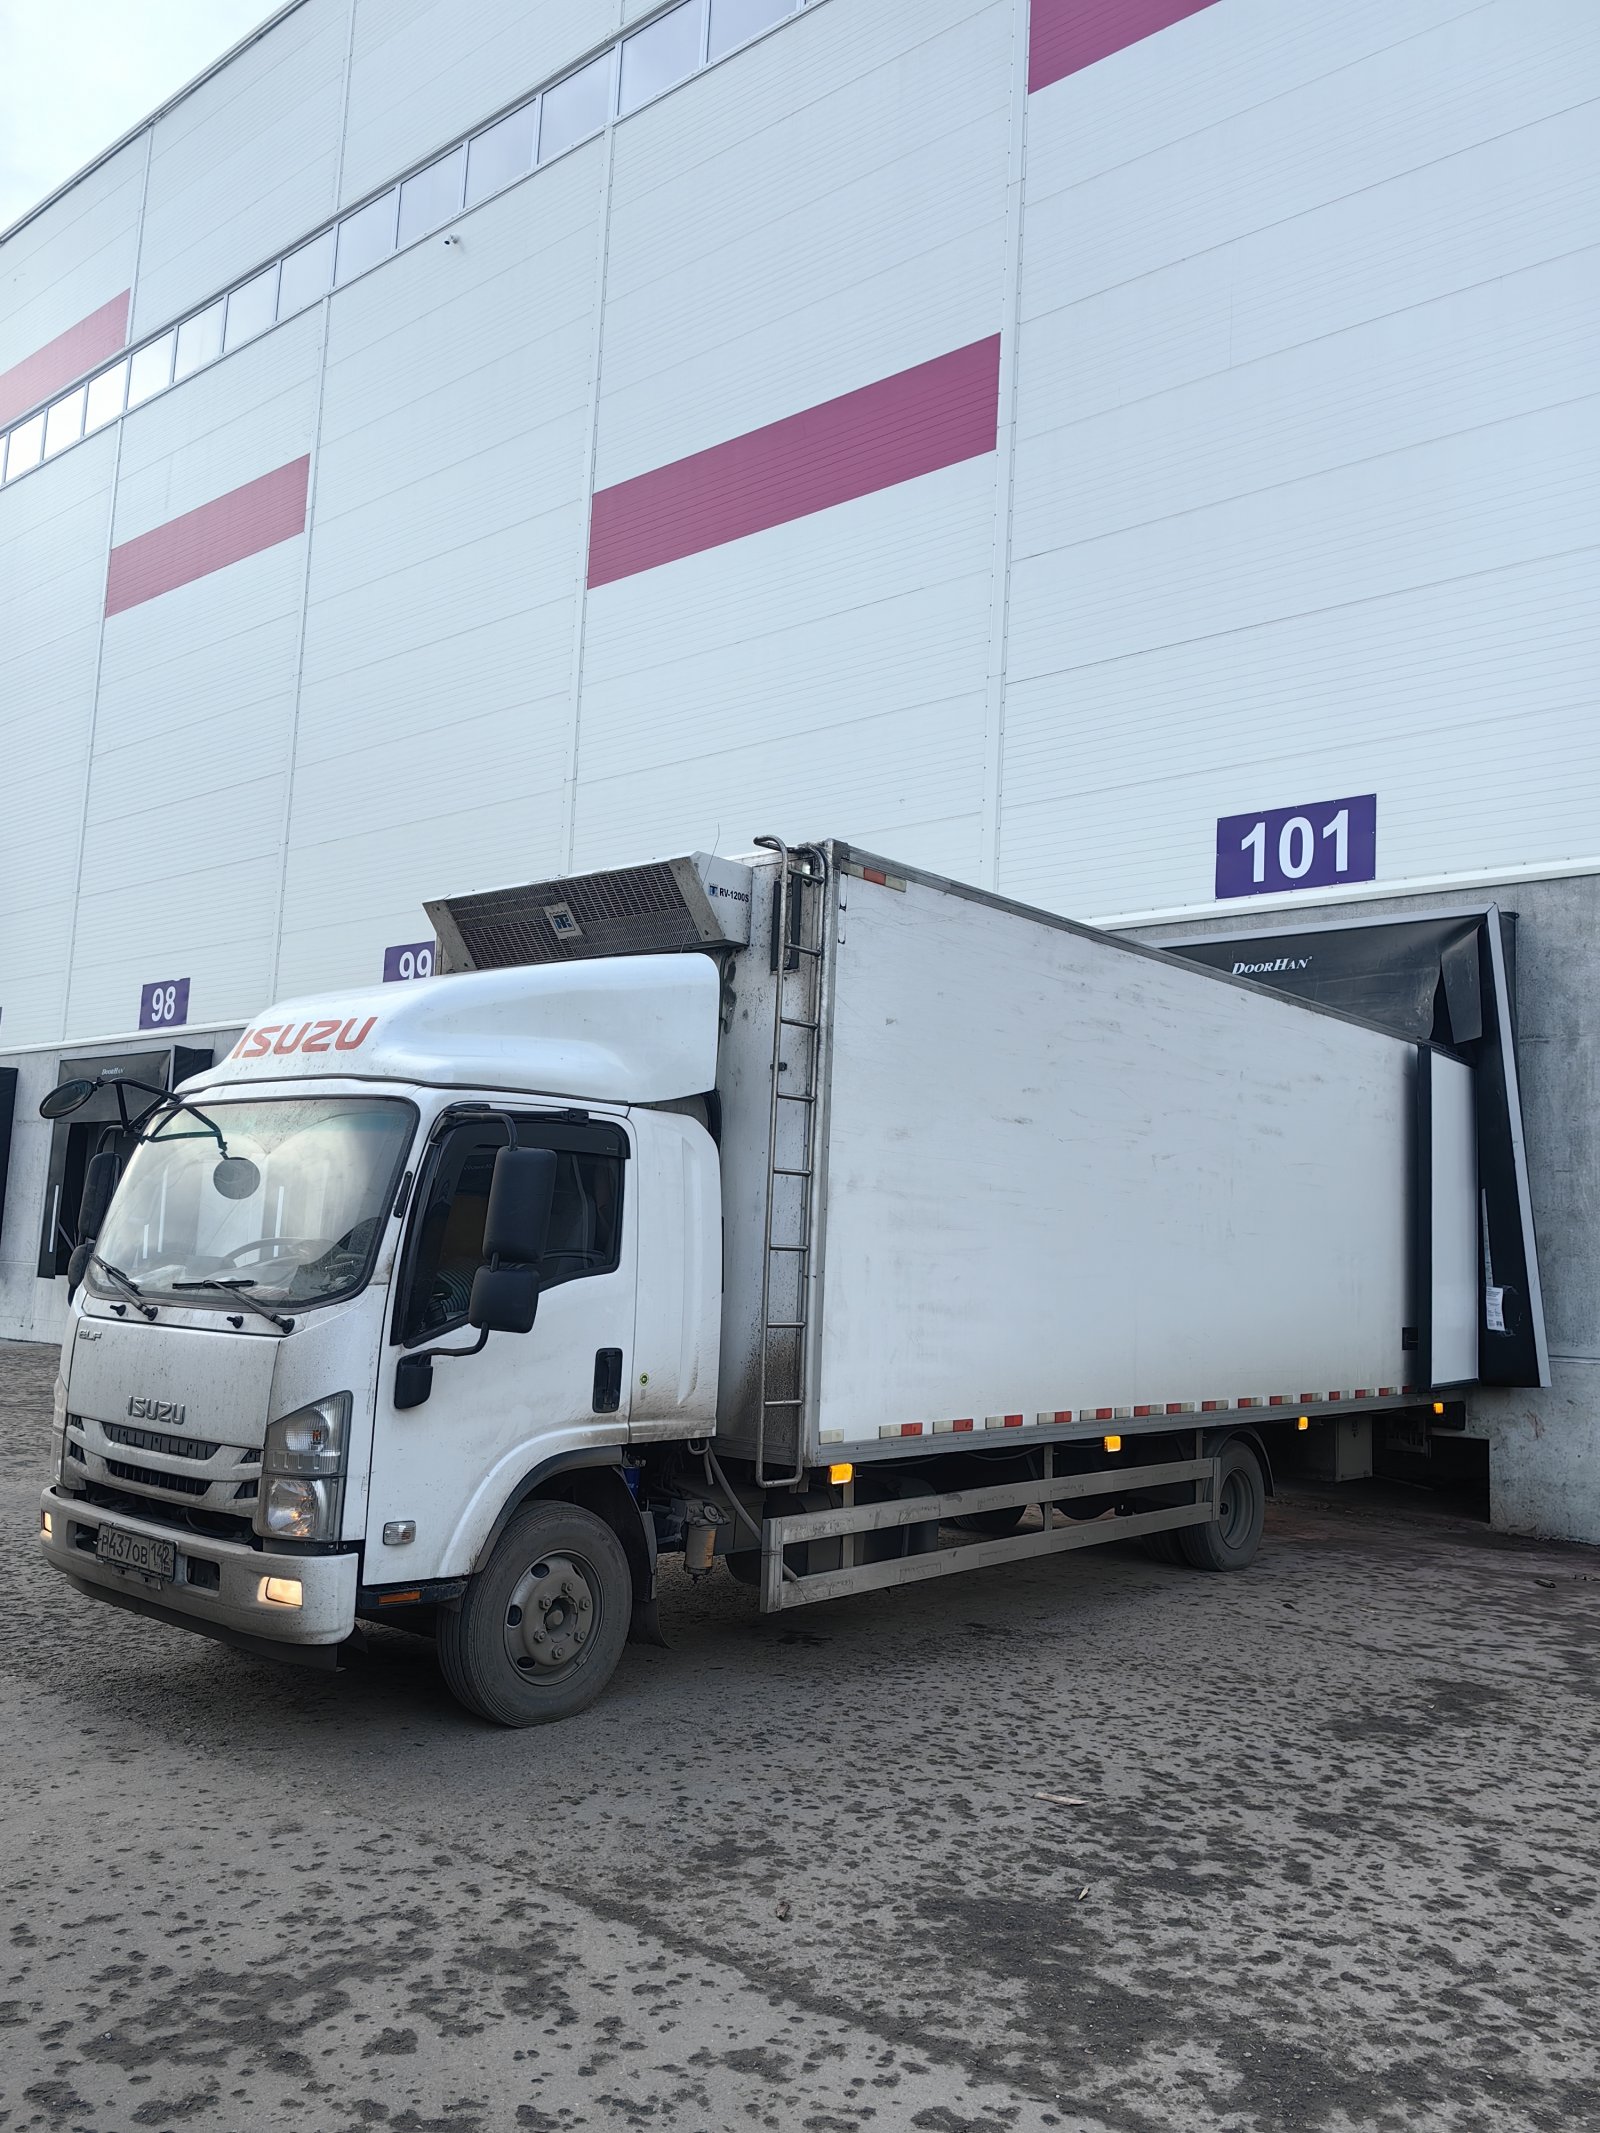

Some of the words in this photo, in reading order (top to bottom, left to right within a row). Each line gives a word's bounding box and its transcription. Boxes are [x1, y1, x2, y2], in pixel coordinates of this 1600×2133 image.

[1241, 809, 1349, 883] 101
[399, 949, 432, 980] 99
[151, 986, 176, 1022] 98
[232, 1016, 379, 1060] ISUZU
[79, 1329, 103, 1342] ELF
[127, 1395, 186, 1425] ISUZU
